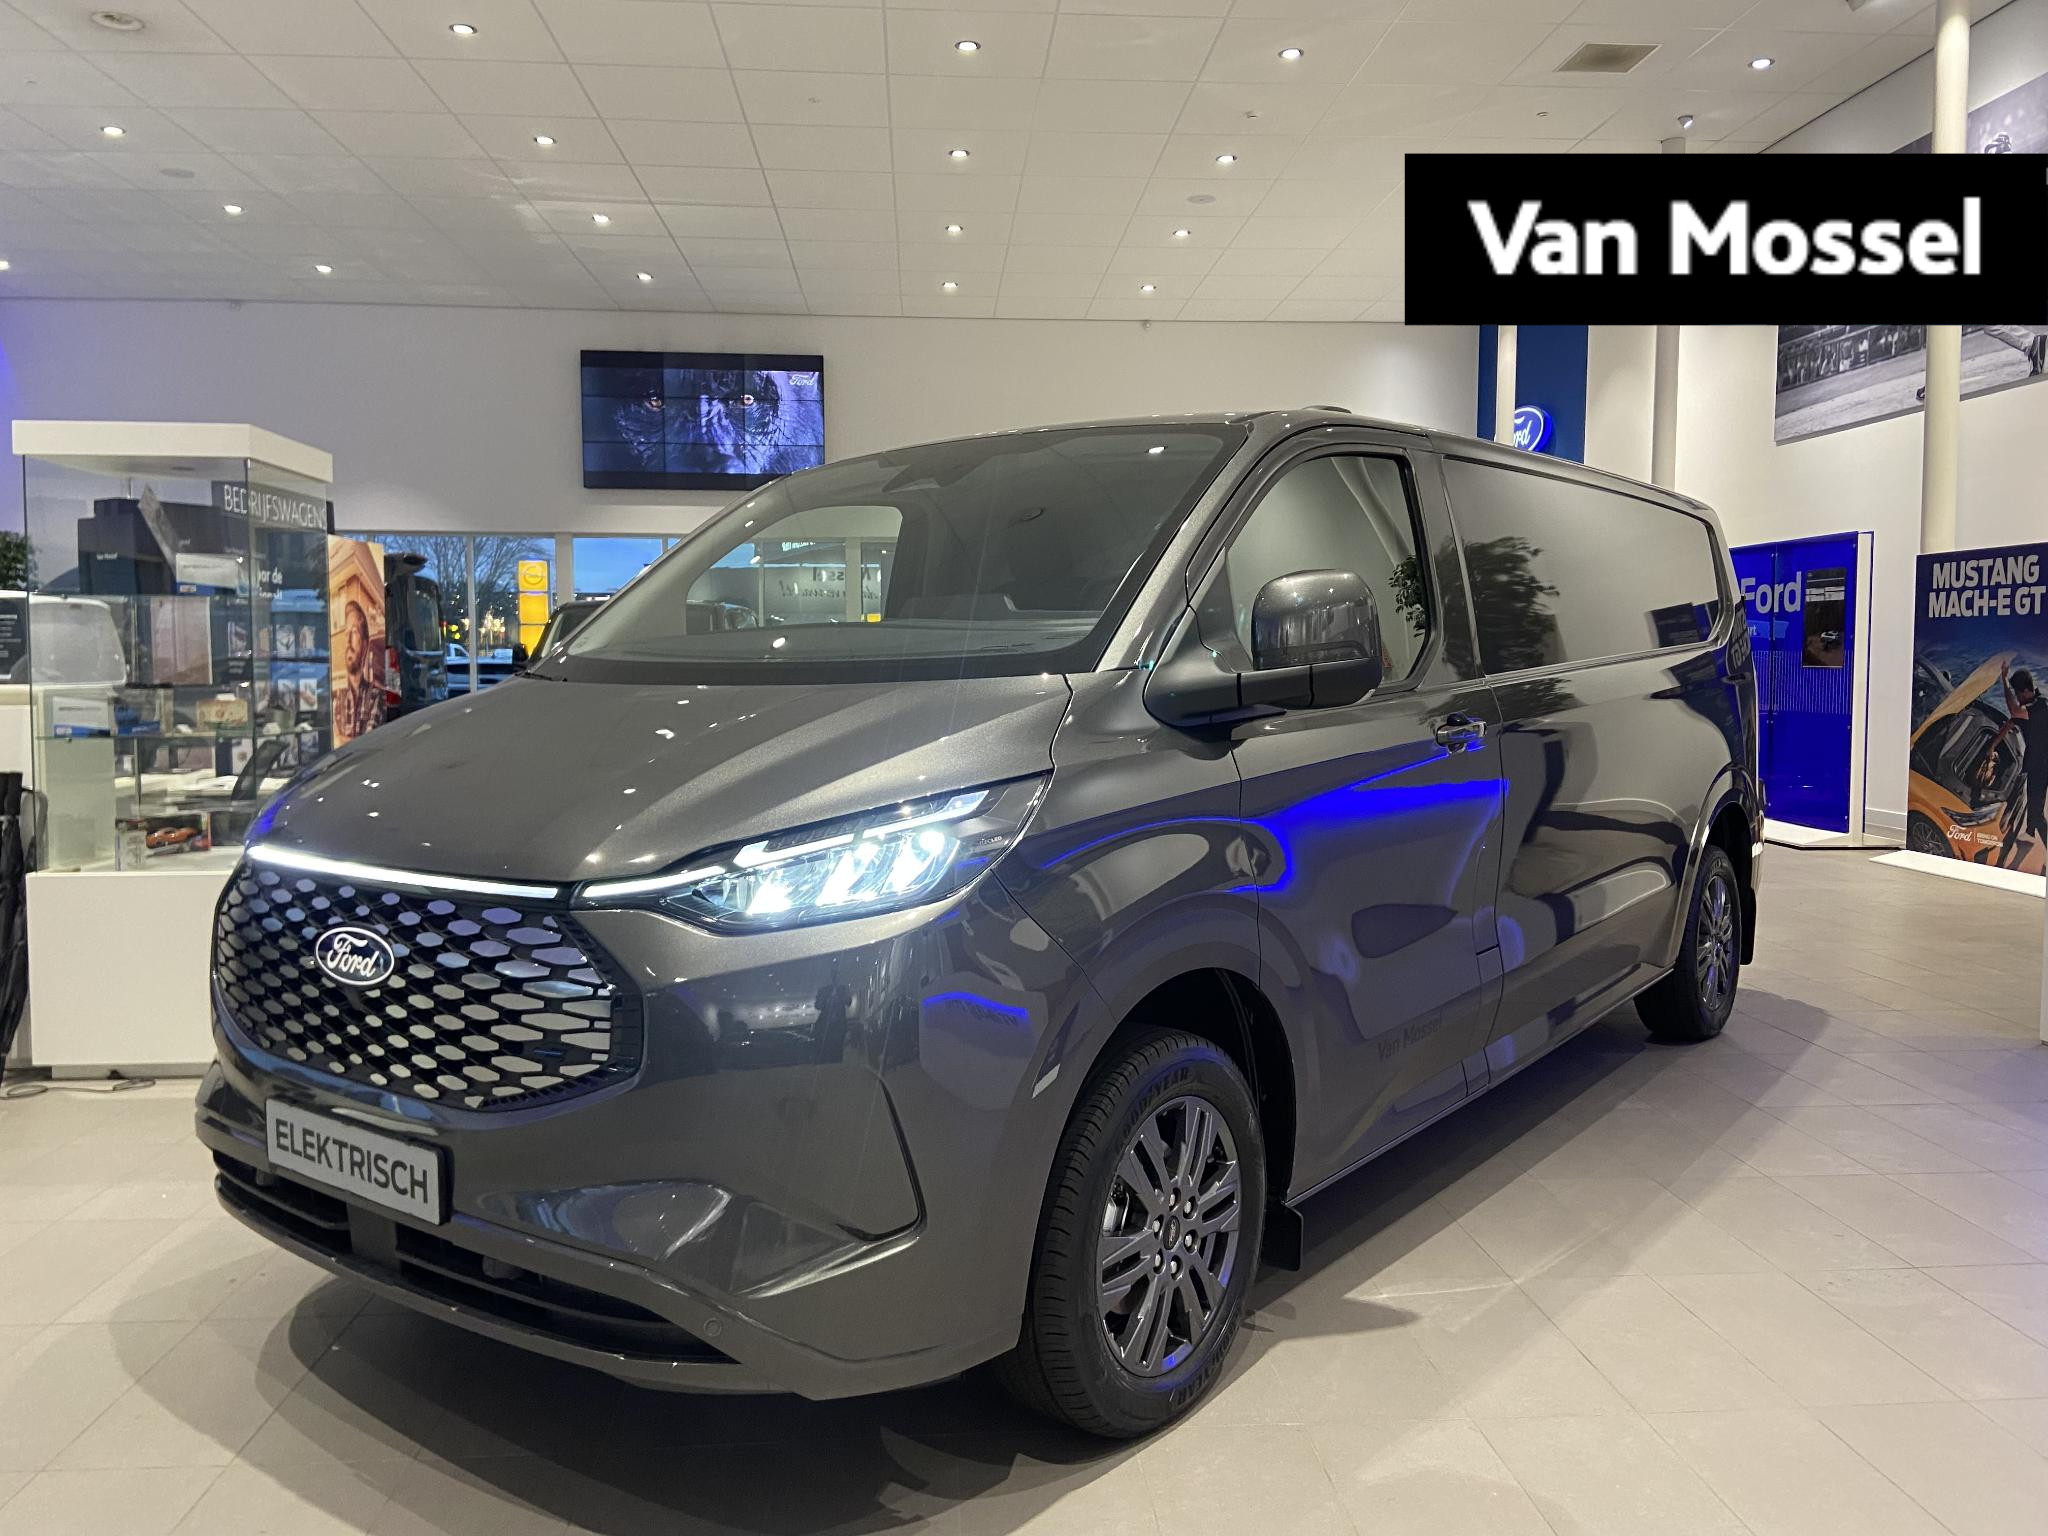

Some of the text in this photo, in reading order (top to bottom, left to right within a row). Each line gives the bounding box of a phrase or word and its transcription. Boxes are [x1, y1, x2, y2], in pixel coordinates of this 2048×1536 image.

[790, 374, 815, 386] Ford
[1514, 416, 1532, 448] rd
[1932, 555, 2040, 589] MUSTANG
[1740, 571, 1802, 614] Ford
[1928, 585, 2047, 618] MACH-E GT
[1947, 824, 1973, 842] Ford
[327, 933, 380, 978] Ford
[275, 1118, 428, 1204] ELEKTRISCH
